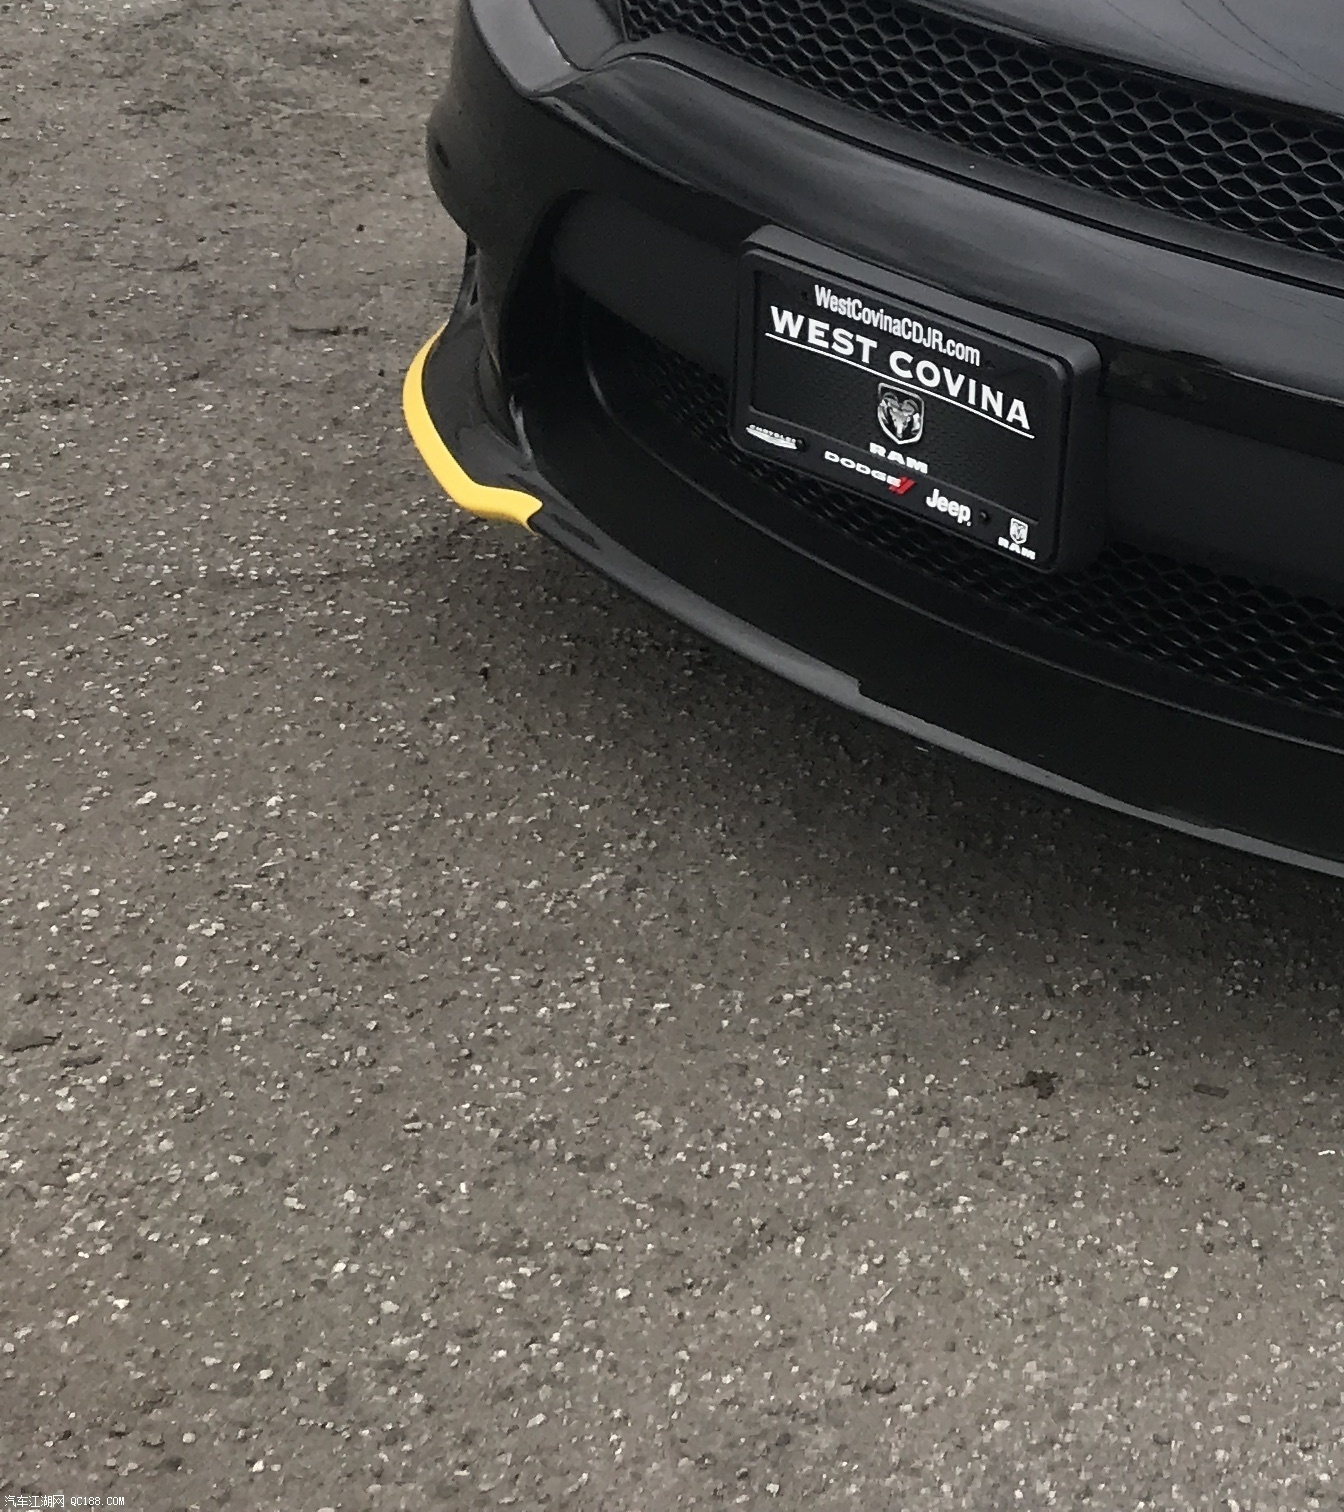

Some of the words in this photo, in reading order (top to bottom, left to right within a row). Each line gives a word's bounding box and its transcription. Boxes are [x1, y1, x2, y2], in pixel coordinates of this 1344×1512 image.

[814, 284, 981, 367] WestCovinaCDJR.com
[770, 305, 878, 364] WEST
[889, 350, 1031, 431] COVINA
[824, 450, 903, 487] DODGE
[869, 442, 929, 475] RAM
[926, 489, 971, 526] Jeep
[998, 536, 1036, 561] RAM
